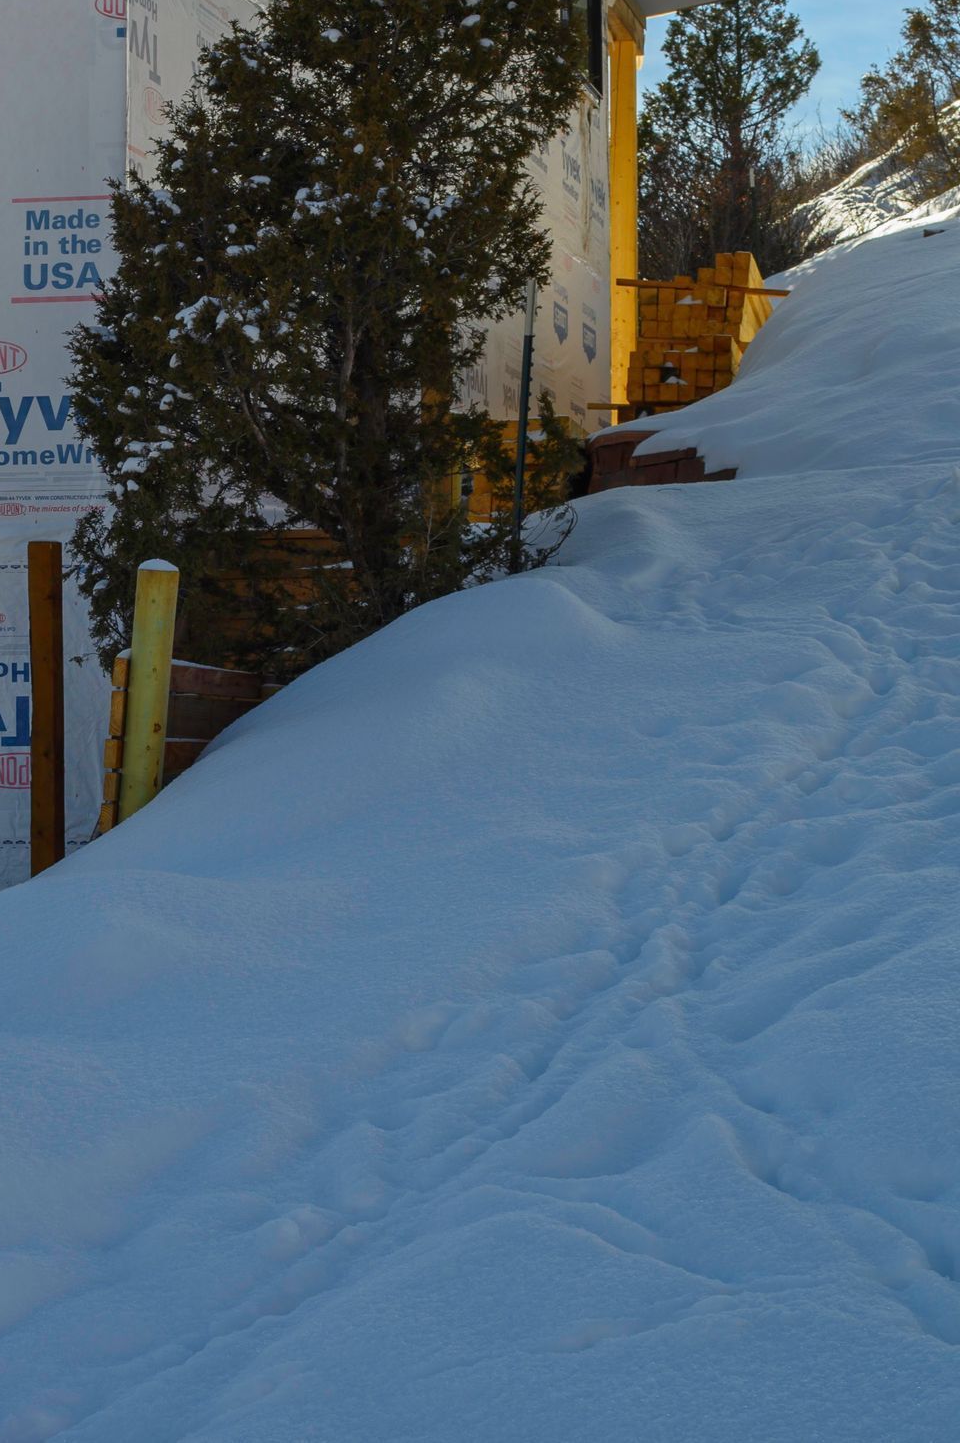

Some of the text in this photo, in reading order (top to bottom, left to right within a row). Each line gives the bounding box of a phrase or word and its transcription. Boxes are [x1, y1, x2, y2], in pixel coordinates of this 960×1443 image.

[26, 210, 100, 231] Made
[24, 235, 102, 256] in the
[23, 263, 102, 291] USA
